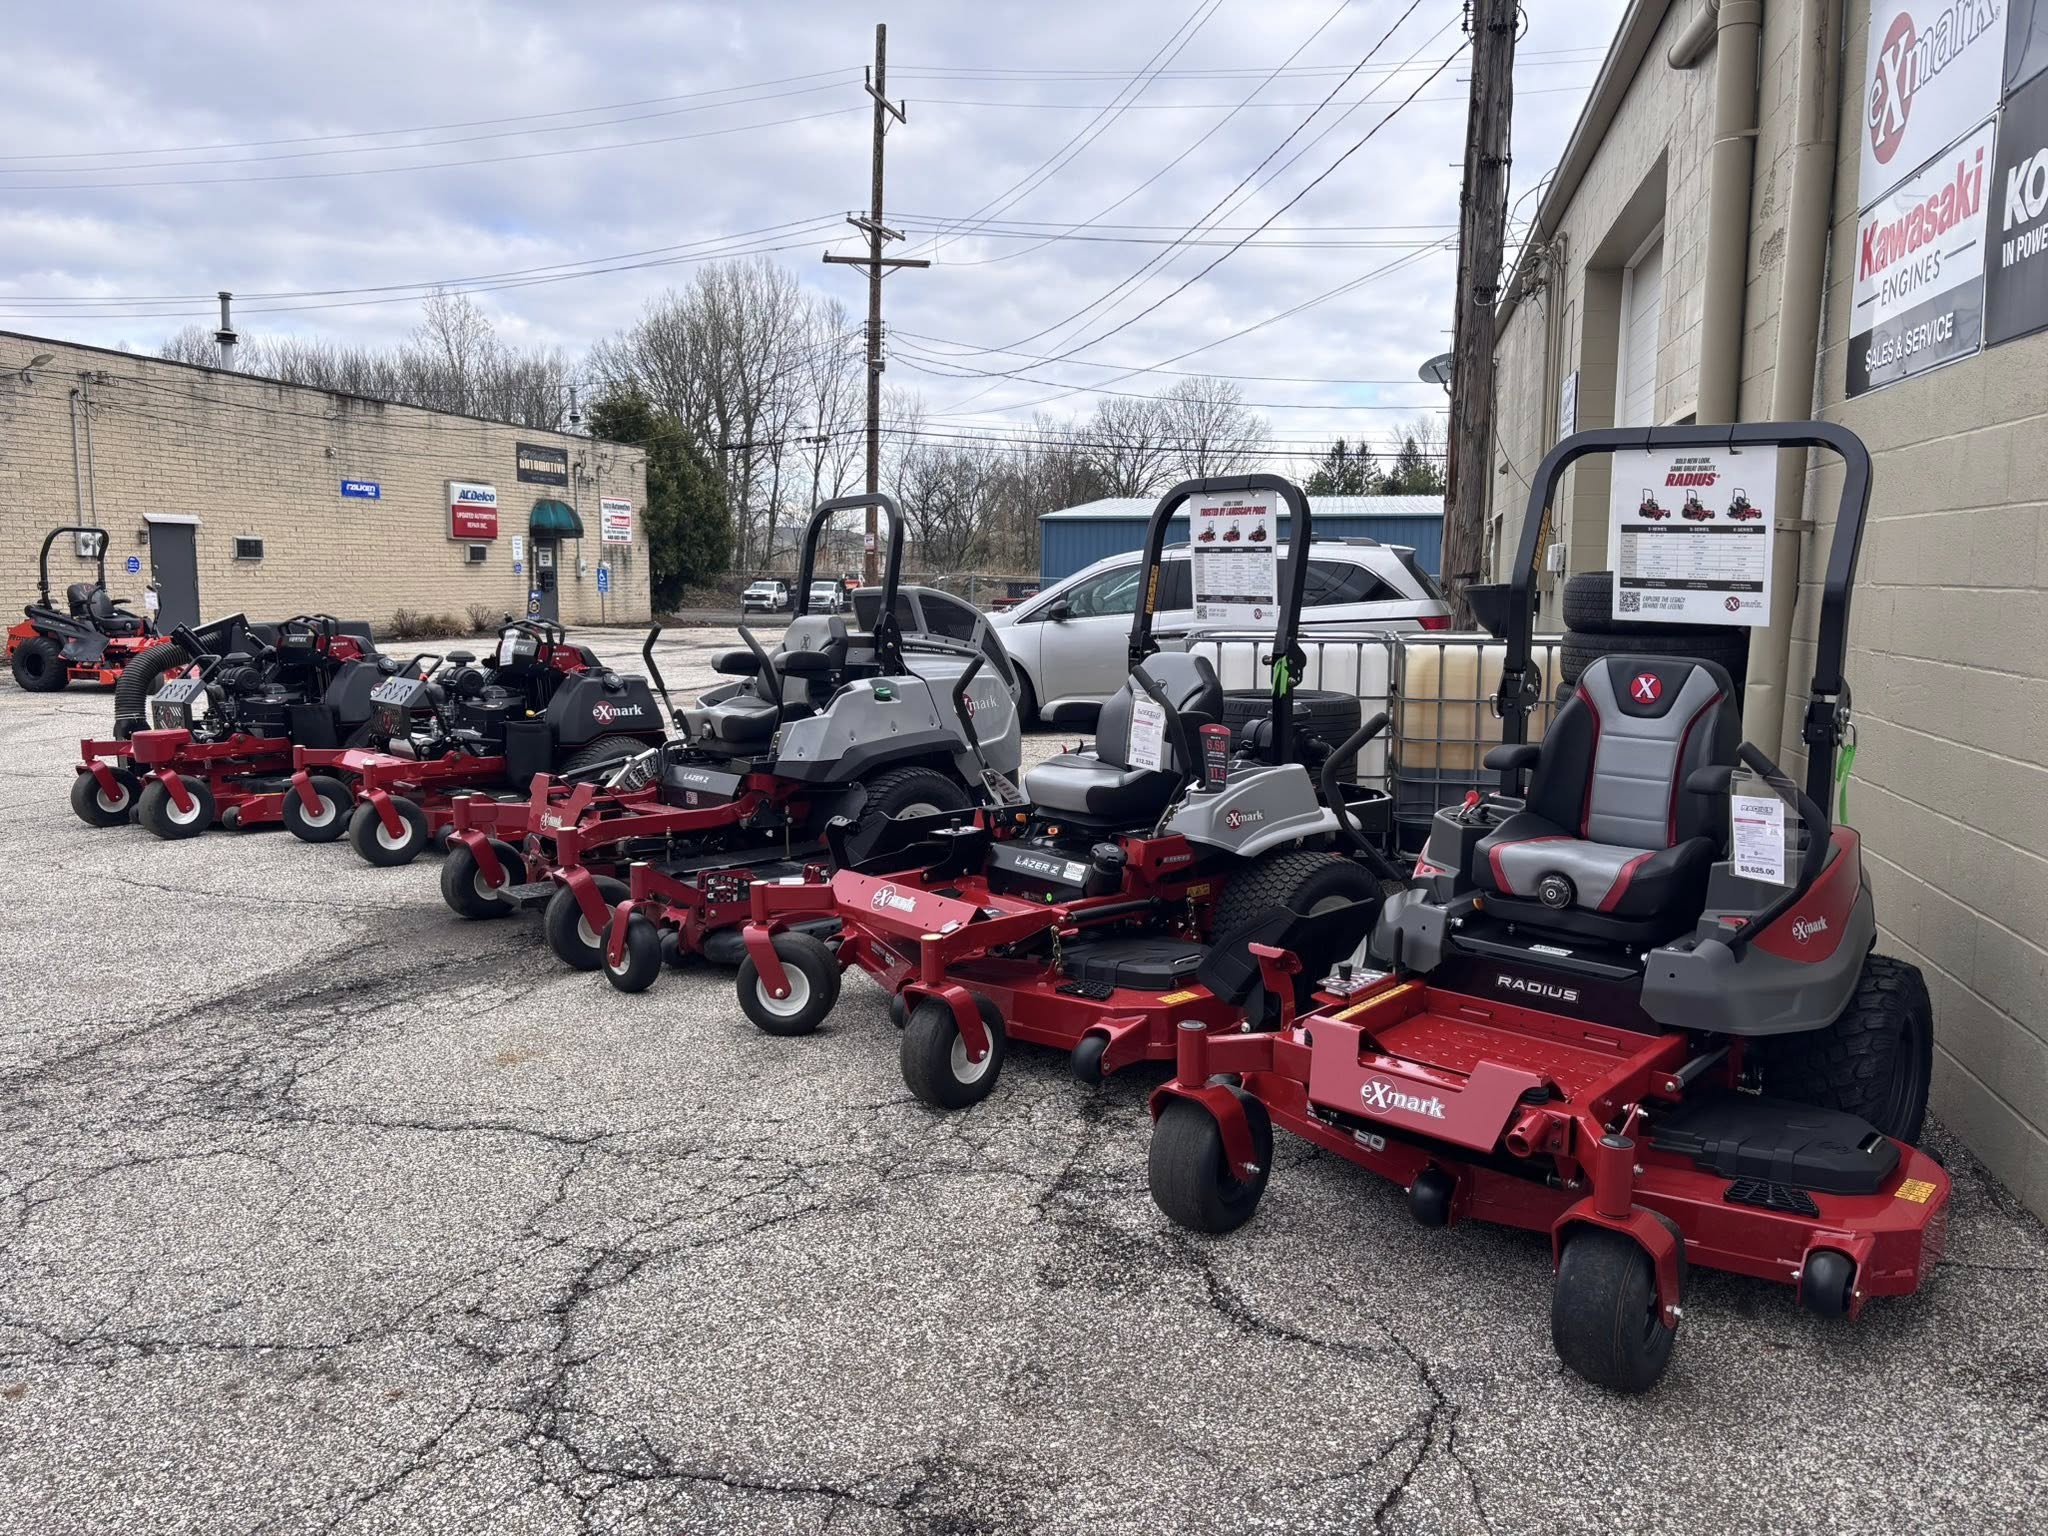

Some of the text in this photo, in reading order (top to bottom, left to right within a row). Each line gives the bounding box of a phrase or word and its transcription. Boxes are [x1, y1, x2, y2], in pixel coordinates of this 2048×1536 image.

[1860, 146, 1984, 282] Kawasaki
[2002, 239, 2014, 268] IN
[1880, 249, 1941, 307] ENGINES
[1864, 312, 1954, 373] SALES & SERVICE
[458, 489, 495, 502] ACDelco
[474, 513, 497, 521] AUTOMOTIVE
[592, 704, 644, 720] eXmark
[1225, 810, 1264, 827] eXmark
[1014, 855, 1050, 873] LAZER
[1050, 864, 1061, 876] Z
[1792, 915, 1828, 940] eXmark
[1497, 975, 1579, 1002] RADIUS
[1361, 1080, 1447, 1119] eXmark
